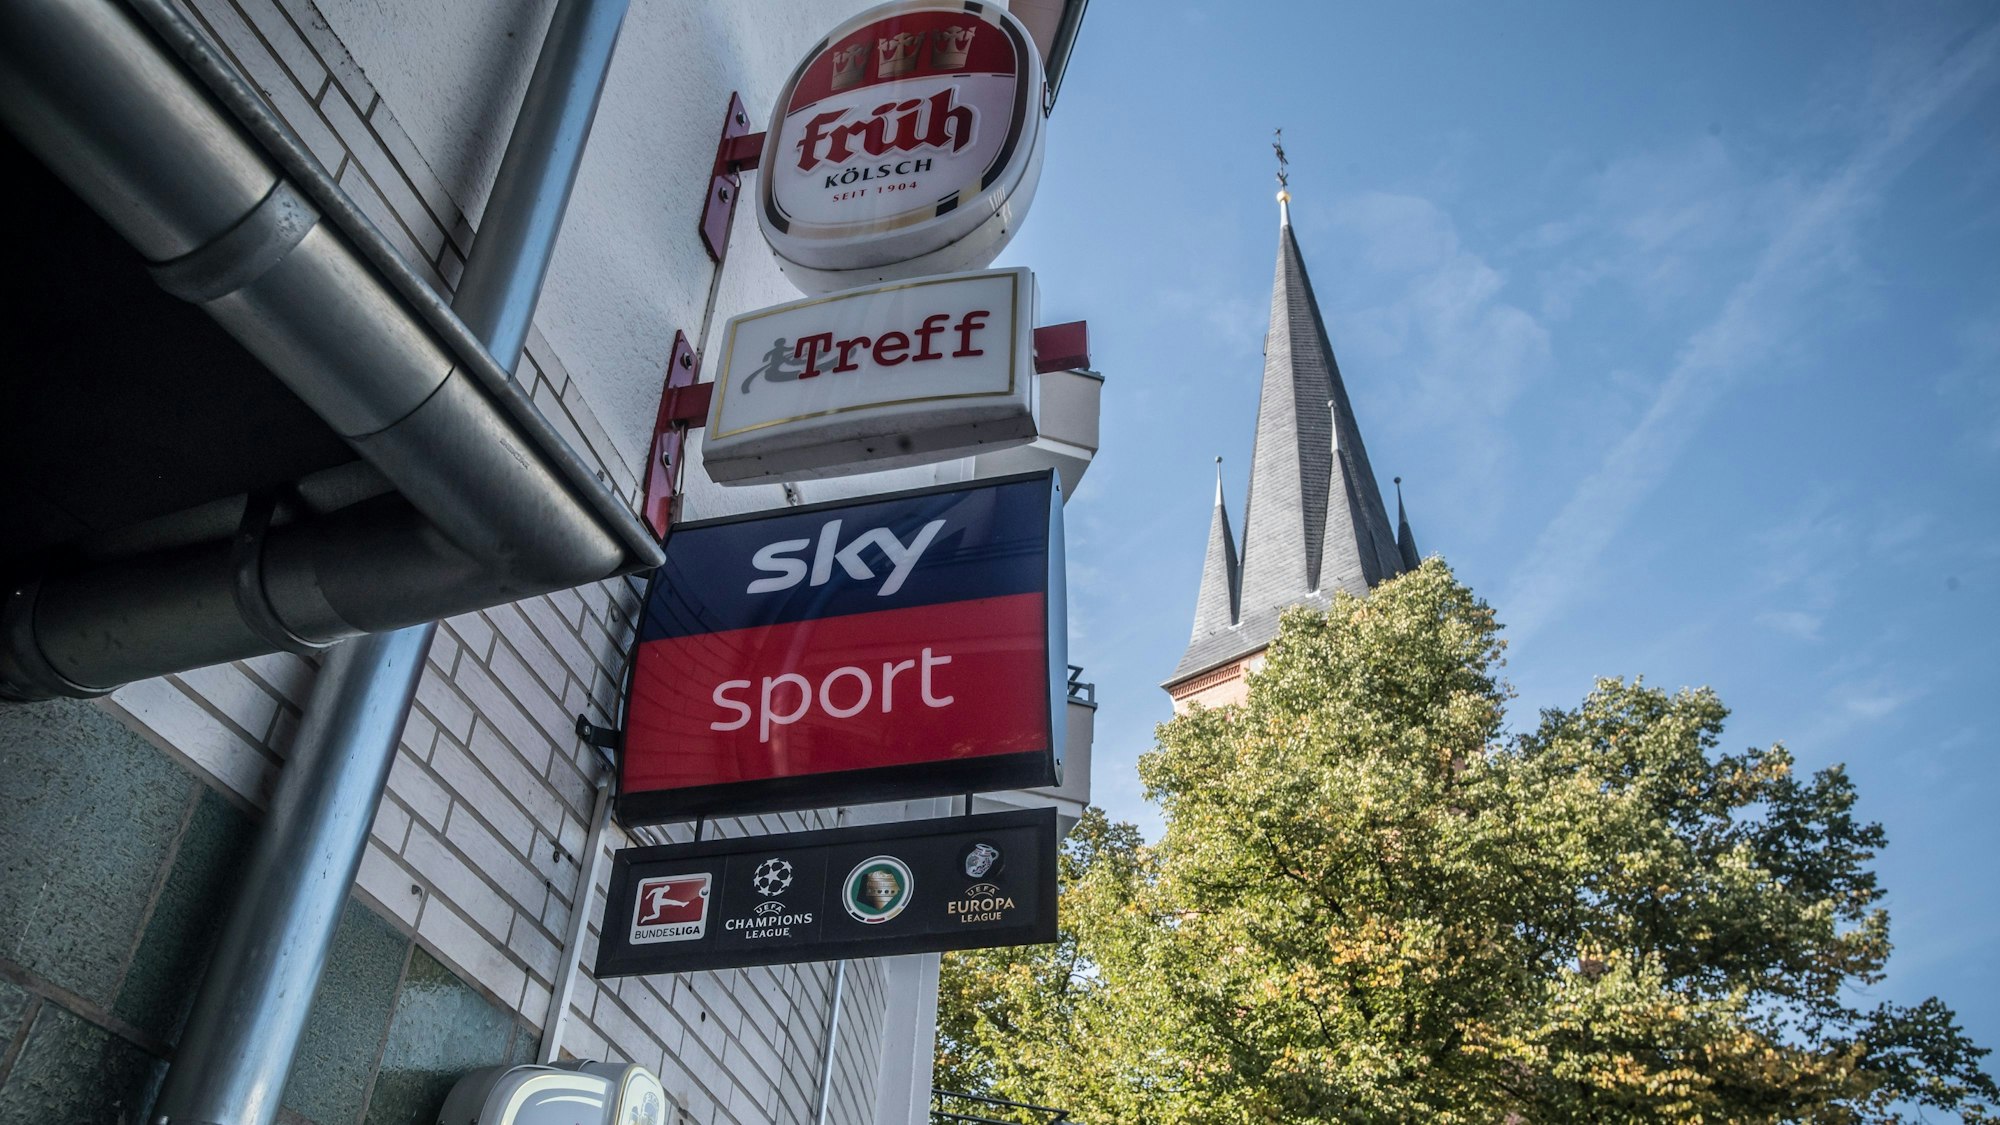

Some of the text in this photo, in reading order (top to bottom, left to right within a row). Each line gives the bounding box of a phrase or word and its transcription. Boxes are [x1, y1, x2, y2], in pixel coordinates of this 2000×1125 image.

[825, 158, 932, 189] KÖLSCH
[833, 181, 917, 202] SEIT 1904
[794, 310, 990, 380] Treff
[746, 519, 947, 597] sky
[710, 647, 954, 743] sport
[965, 885, 996, 897] UEFA
[756, 903, 782, 914] UEFA
[947, 897, 1015, 914] EUROPA
[725, 913, 813, 931] CHAMPIONS
[961, 911, 1002, 923] LEAGUE
[634, 926, 701, 939] BUNDESLIGA
[745, 927, 790, 939] LEAGUE
